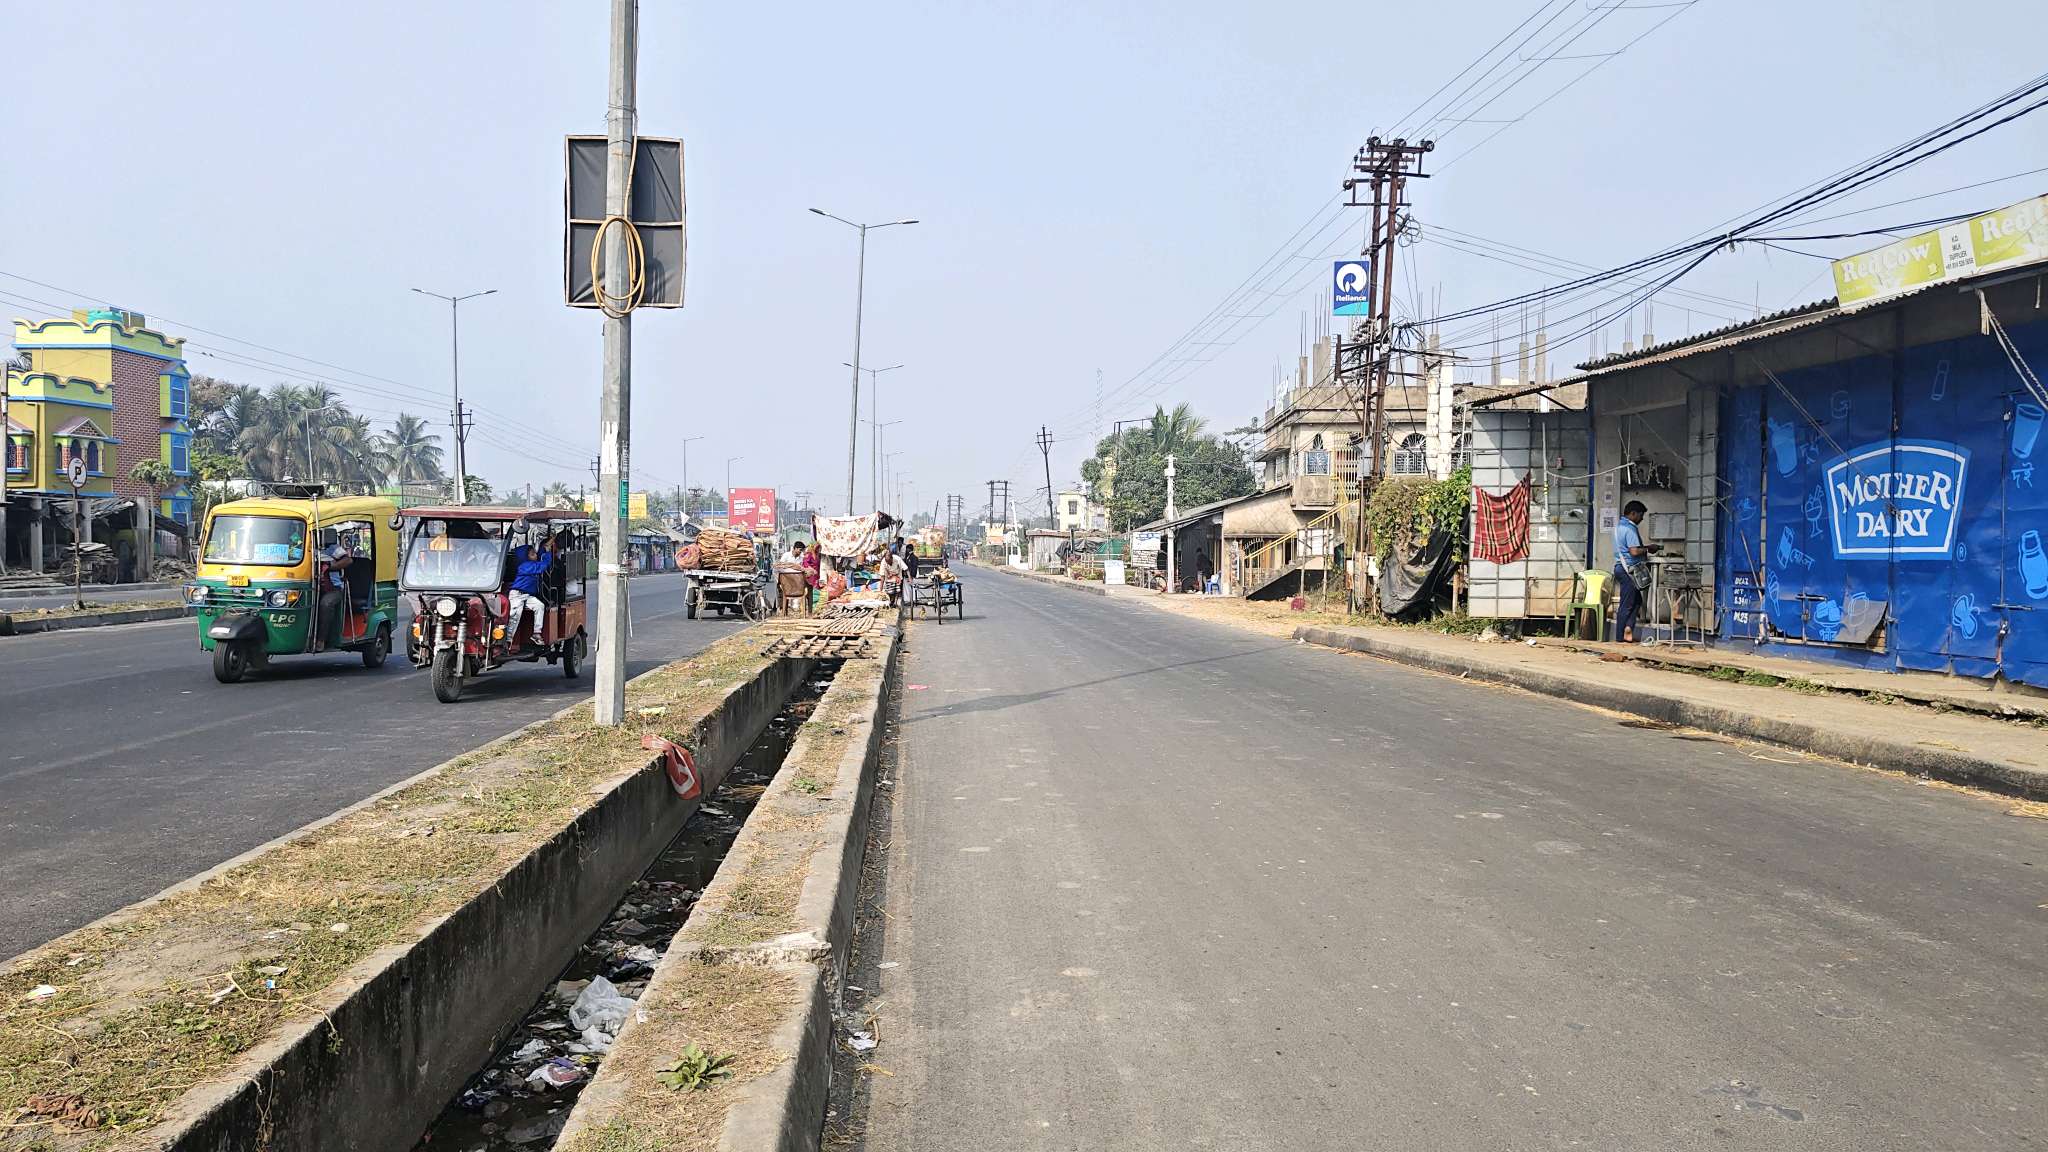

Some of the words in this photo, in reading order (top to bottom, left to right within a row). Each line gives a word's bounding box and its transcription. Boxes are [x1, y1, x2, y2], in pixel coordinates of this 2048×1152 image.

[1336, 294, 1367, 302] Reliance
[1837, 470, 1955, 514] MOTHER
[1856, 508, 1934, 537] DAIRY
[269, 613, 296, 623] LPG
